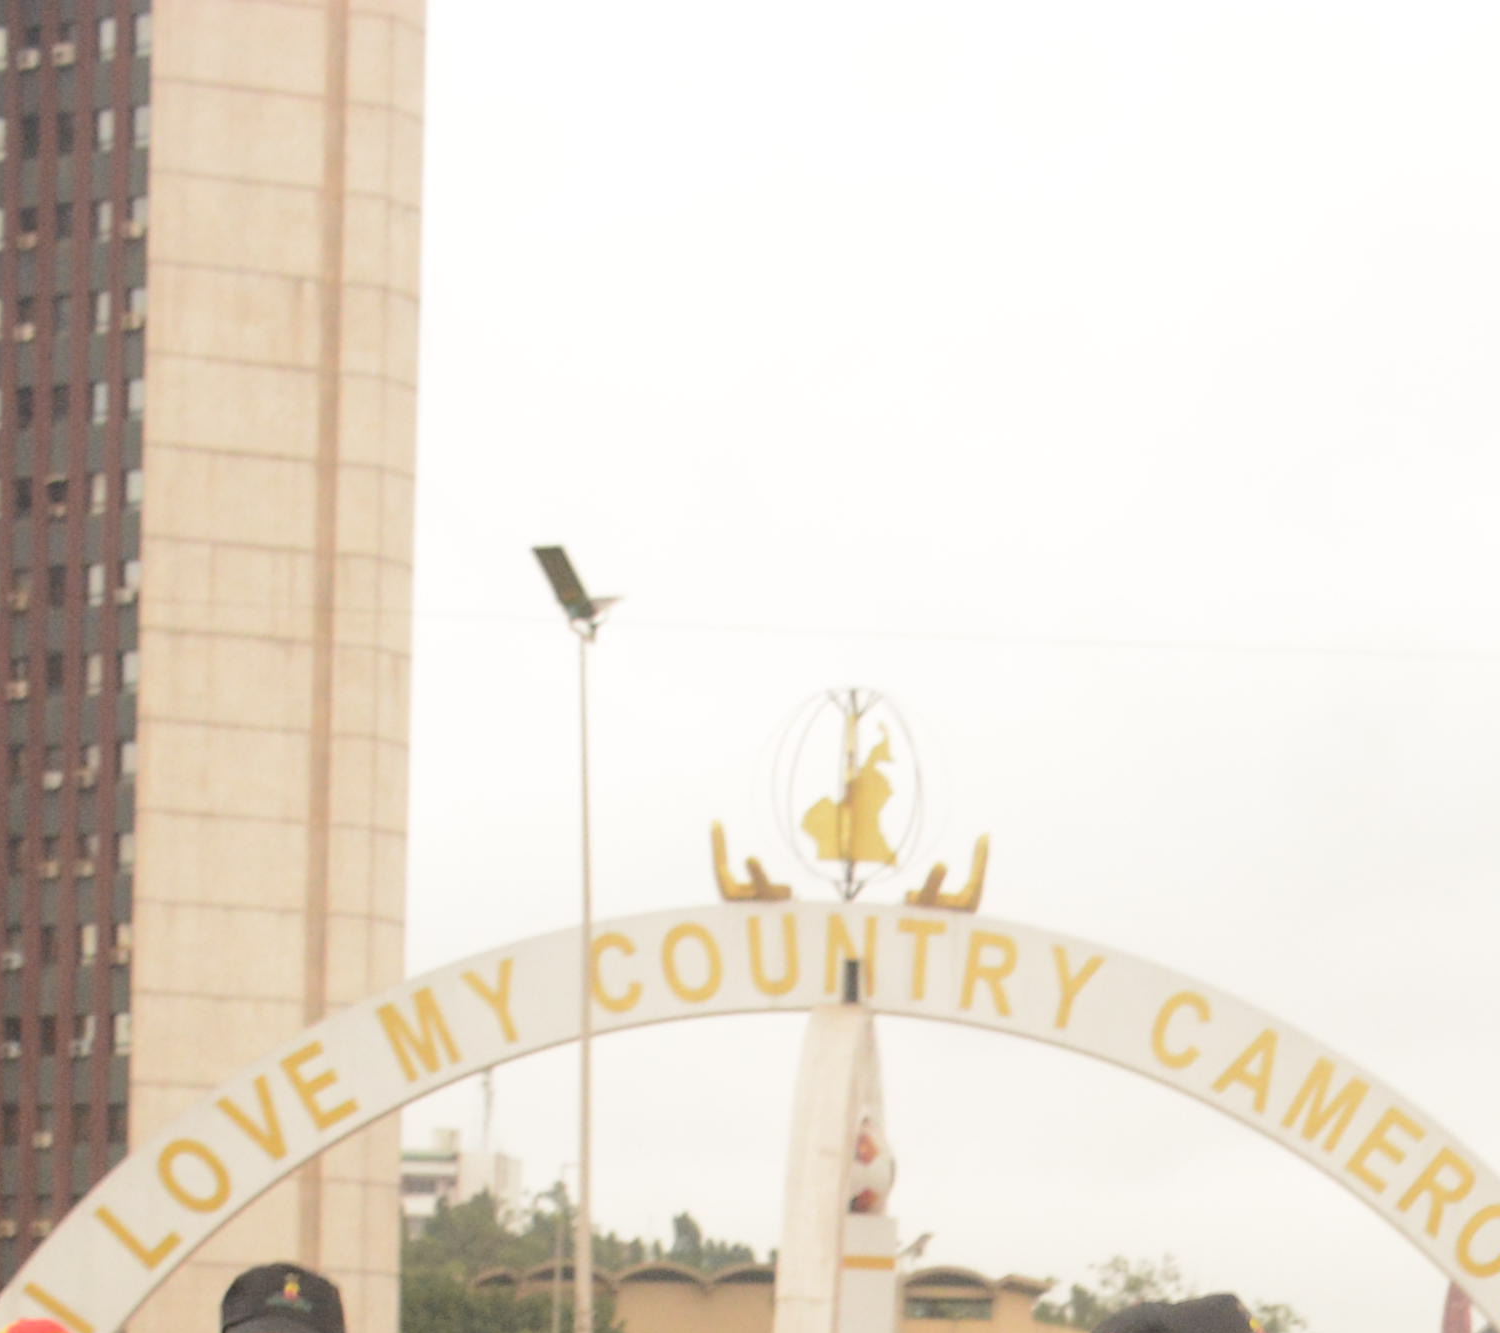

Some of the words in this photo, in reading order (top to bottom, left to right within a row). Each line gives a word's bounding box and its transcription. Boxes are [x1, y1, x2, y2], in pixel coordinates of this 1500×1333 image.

[95, 1039, 360, 1271] LOVE
[375, 956, 521, 1083] MY
[589, 912, 1107, 1031] COUNTRY
